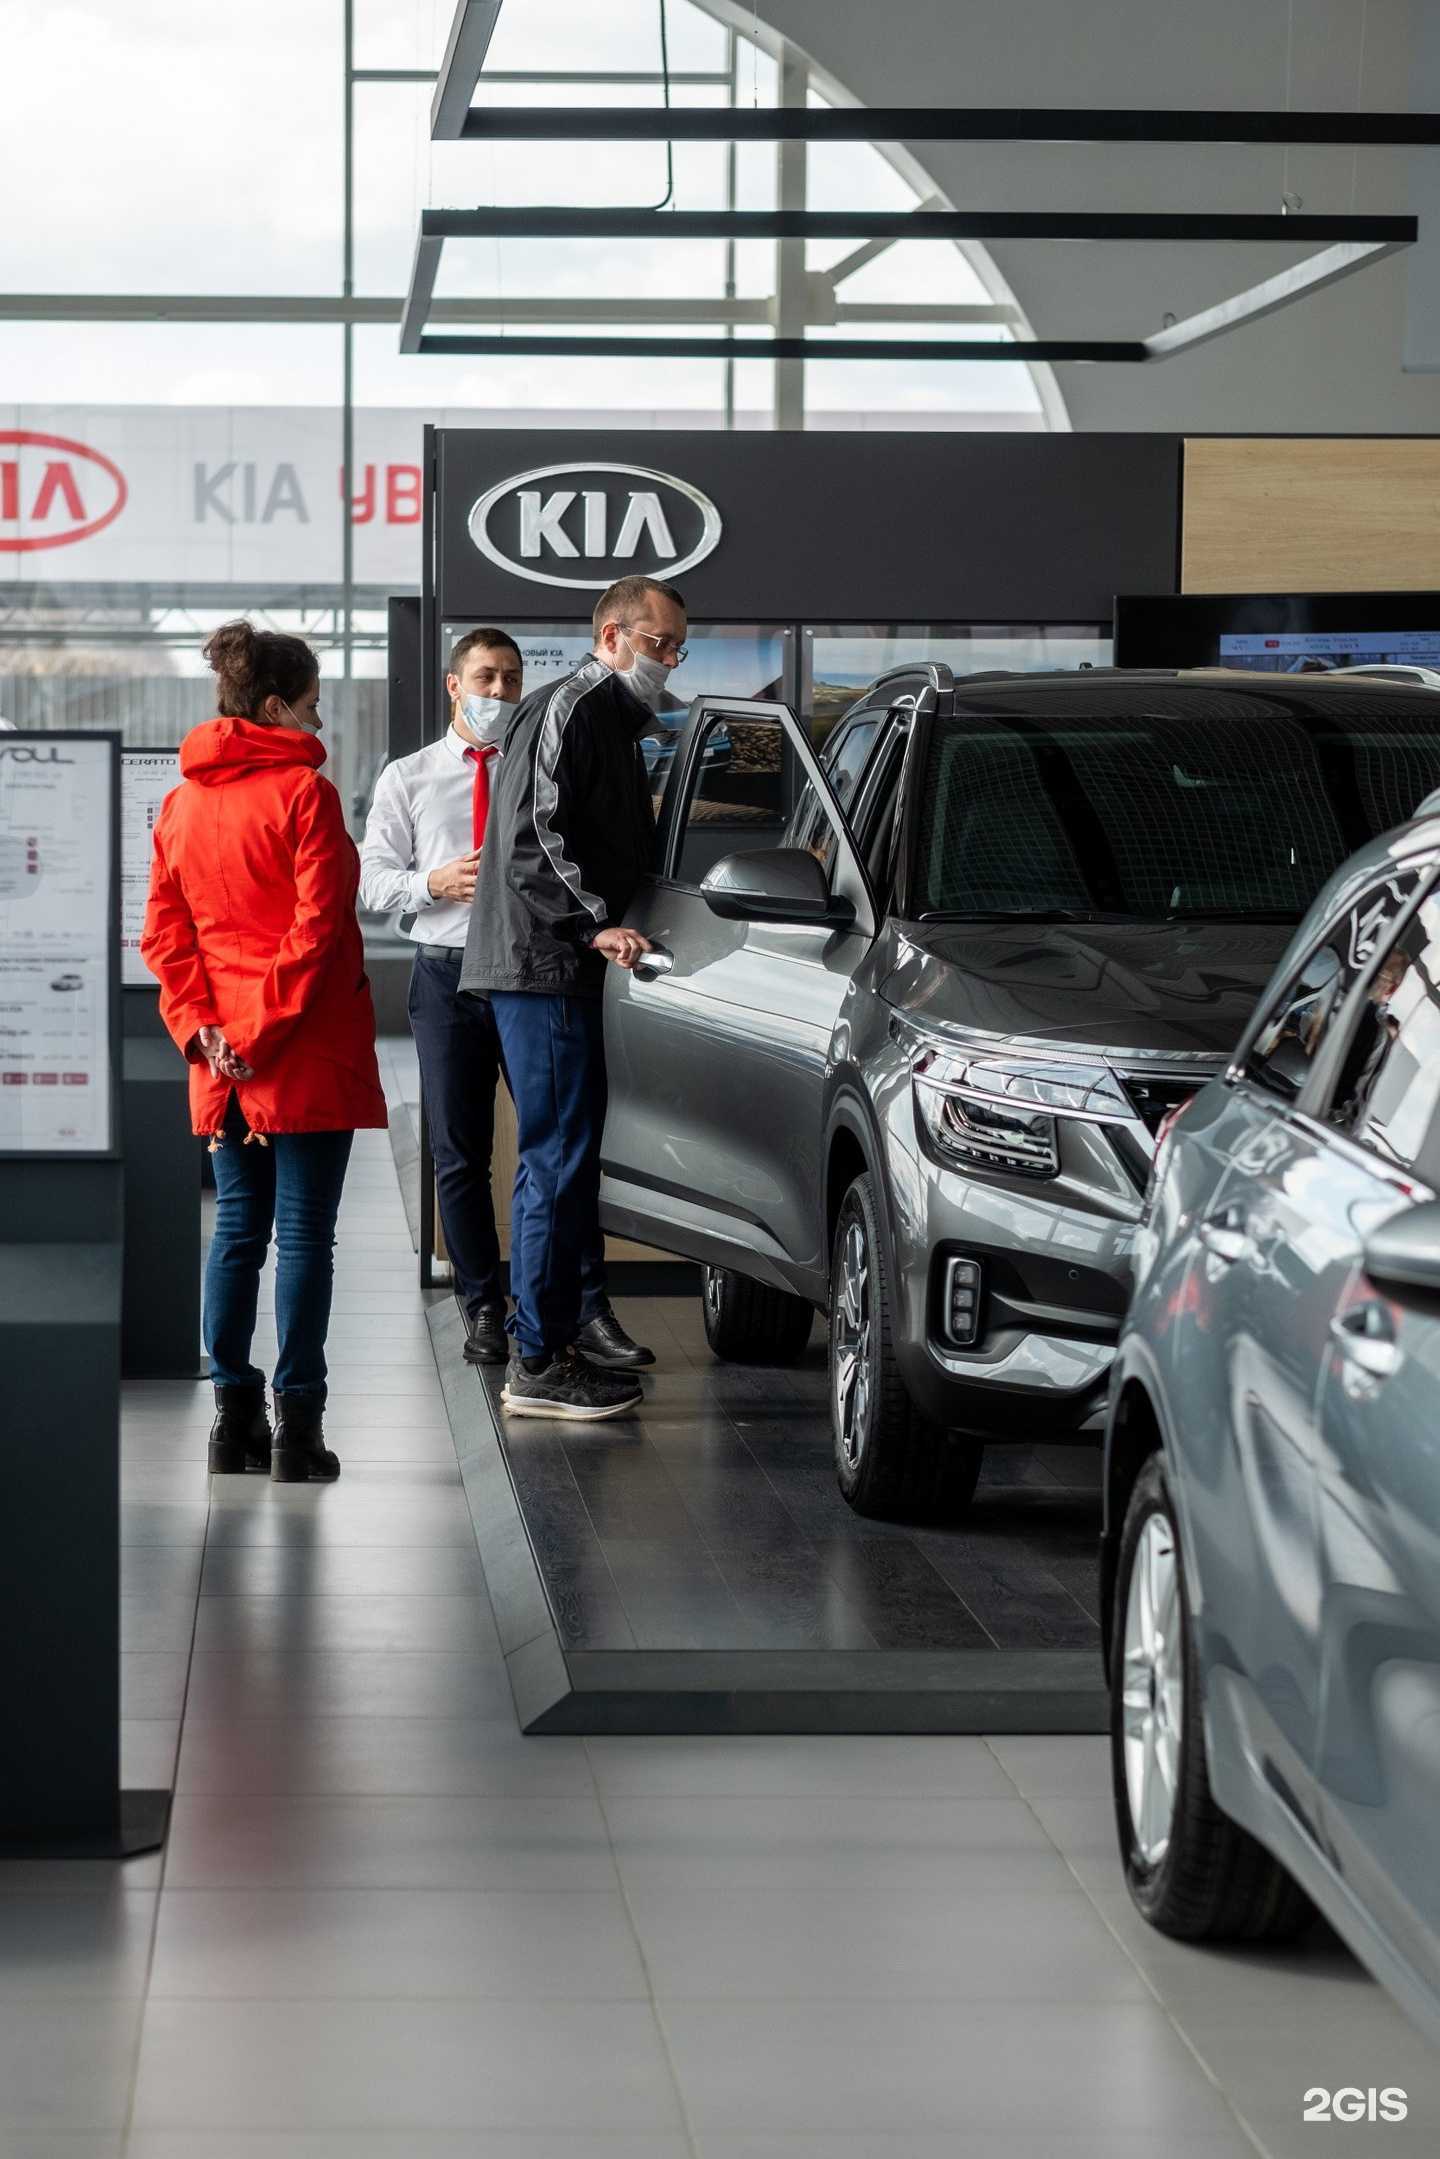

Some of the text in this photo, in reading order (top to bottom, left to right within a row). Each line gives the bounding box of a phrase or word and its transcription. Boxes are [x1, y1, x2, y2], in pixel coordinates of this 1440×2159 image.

[0, 462, 87, 520] IA
[194, 462, 310, 524] KIA
[517, 491, 677, 558] KIA
